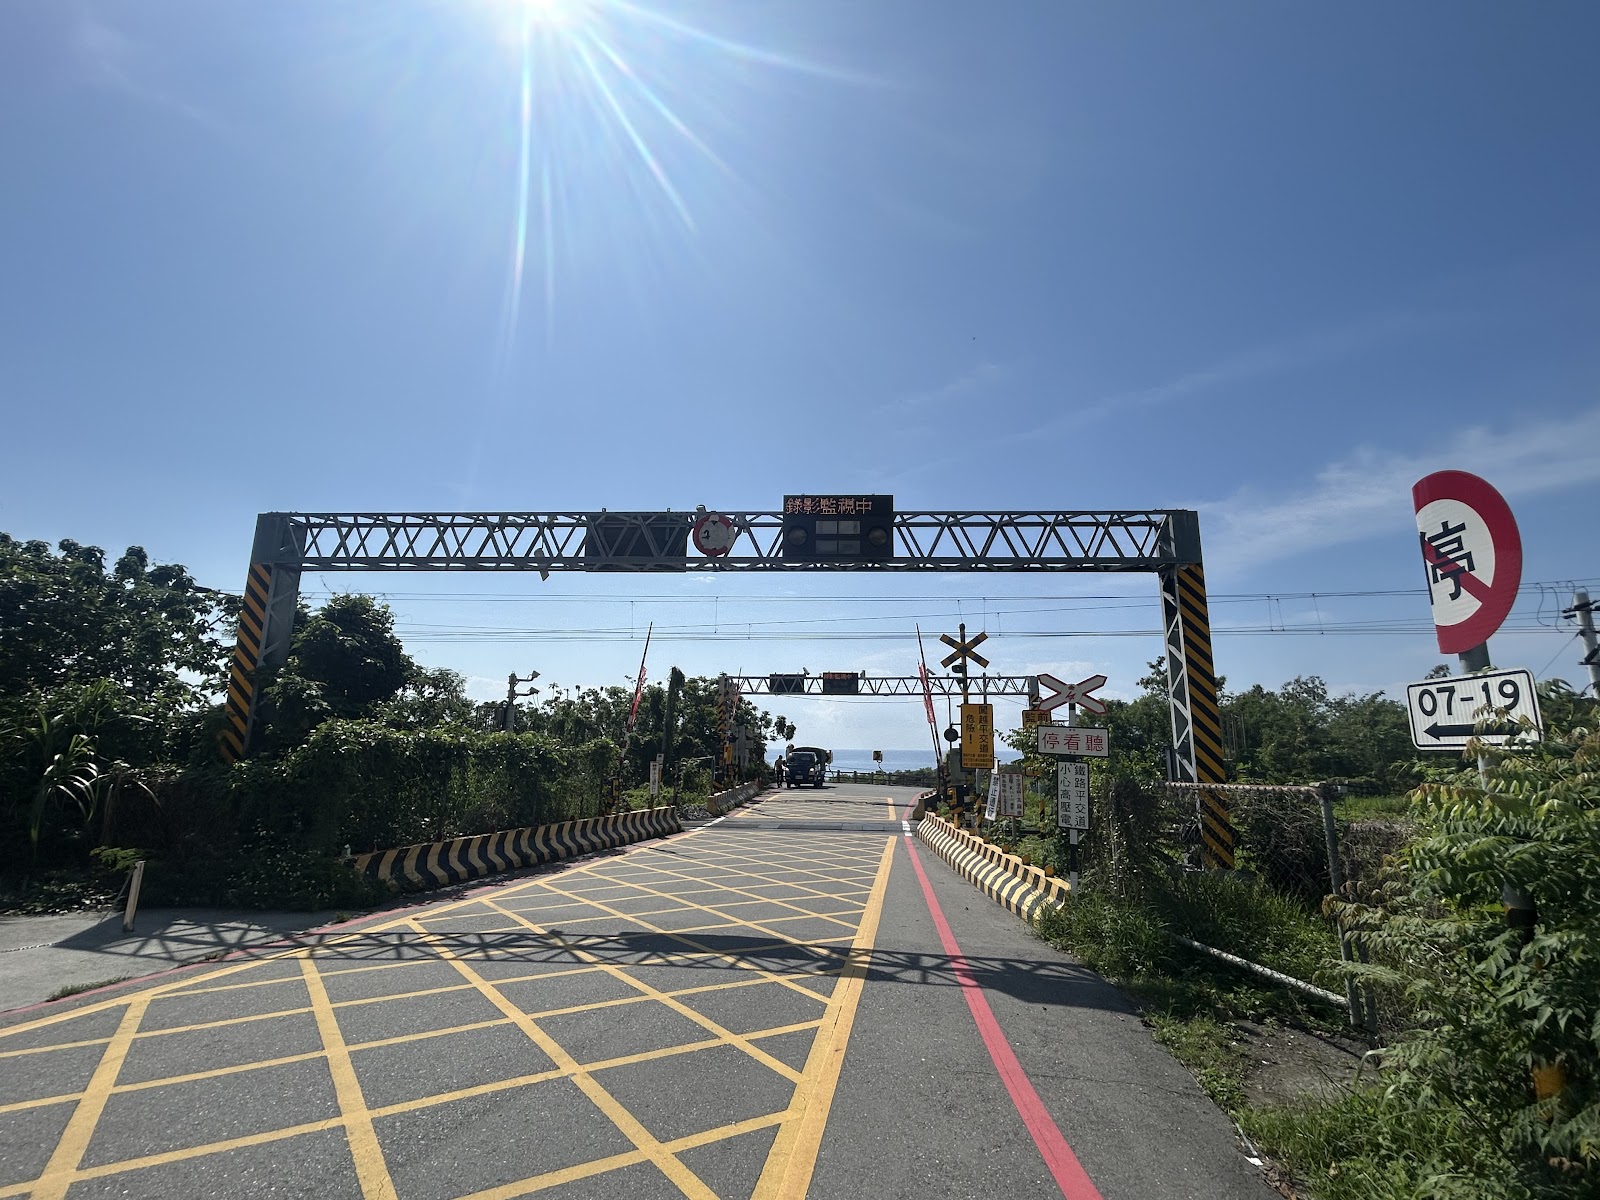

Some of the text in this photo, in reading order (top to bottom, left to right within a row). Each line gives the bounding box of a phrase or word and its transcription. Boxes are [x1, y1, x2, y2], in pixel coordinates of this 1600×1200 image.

[785, 497, 873, 515] 錄影監視中
[1418, 678, 1521, 717] 07-19
[1042, 732, 1104, 752] 停看聽
[1060, 763, 1073, 827] 小心高壓電
[1074, 765, 1087, 828] 鐵路平交道
